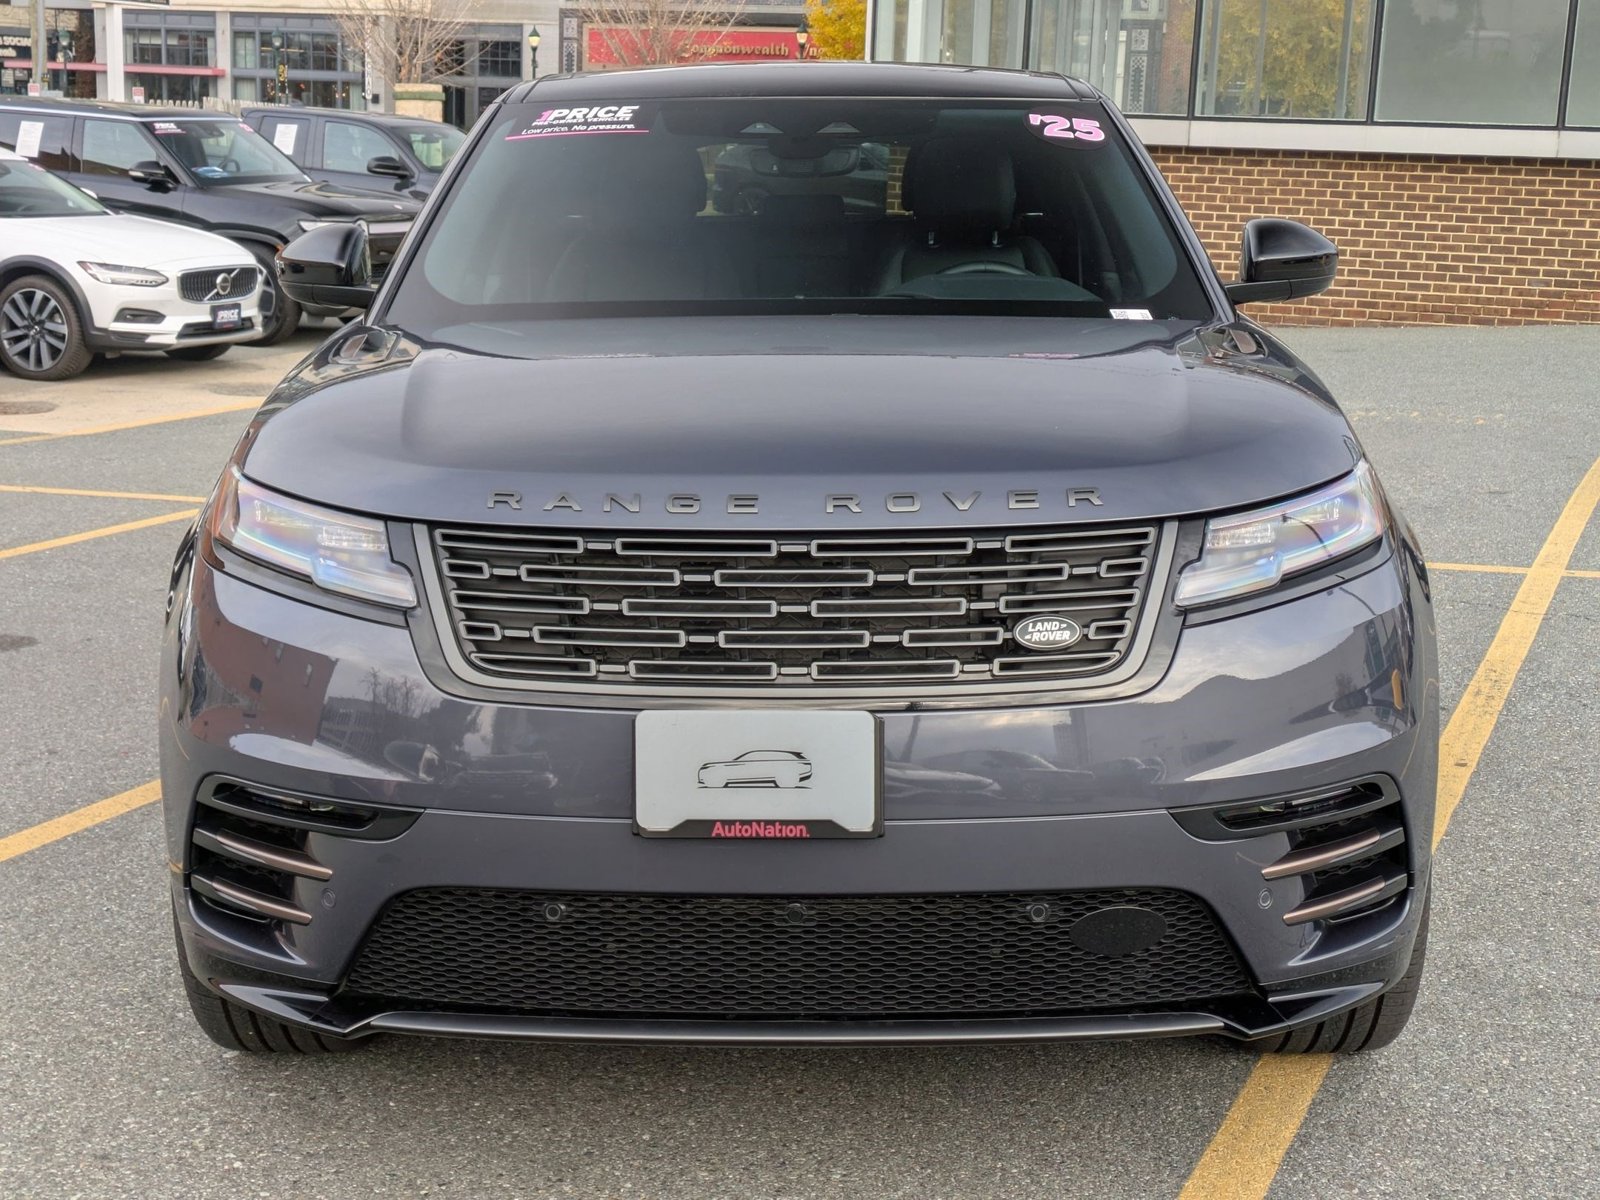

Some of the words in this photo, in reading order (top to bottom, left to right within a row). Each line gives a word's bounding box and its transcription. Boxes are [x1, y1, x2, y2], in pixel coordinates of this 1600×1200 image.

[536, 106, 640, 122] 1PRICE
[1028, 113, 1105, 141] '25
[487, 490, 759, 513] RANGE
[825, 486, 1104, 514] ROVER
[1027, 621, 1060, 632] LAND
[1031, 630, 1071, 642] ROVER
